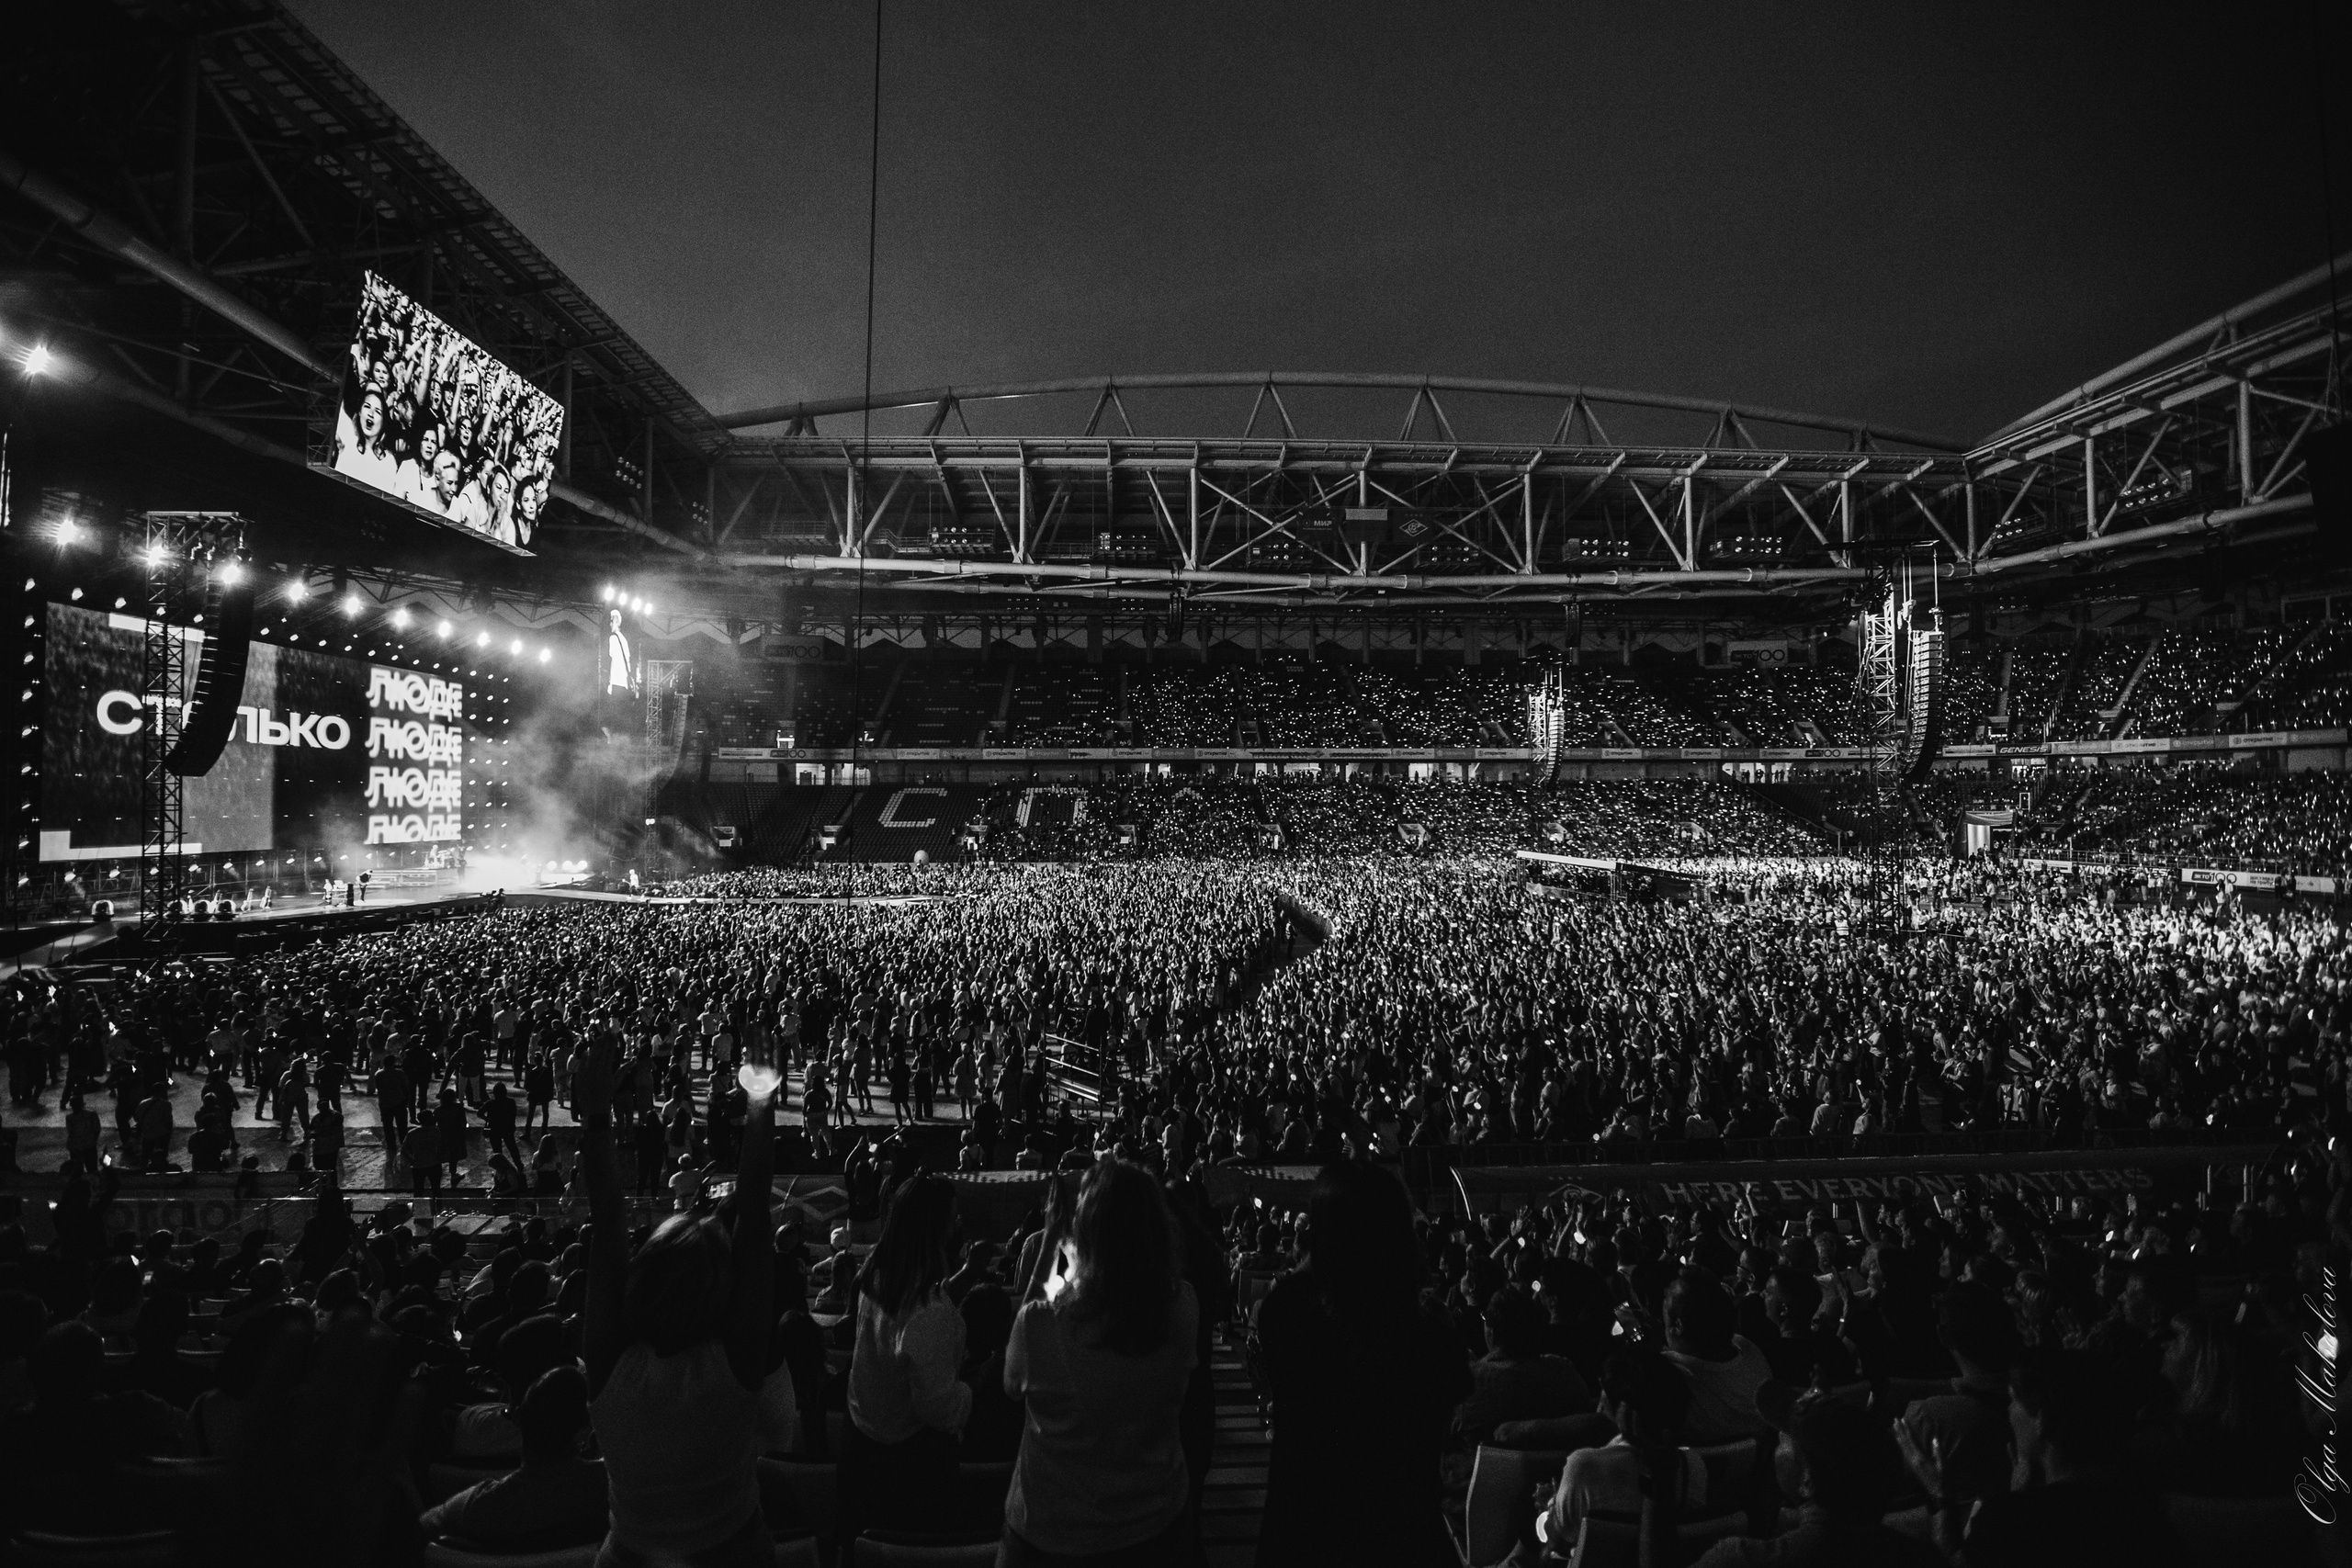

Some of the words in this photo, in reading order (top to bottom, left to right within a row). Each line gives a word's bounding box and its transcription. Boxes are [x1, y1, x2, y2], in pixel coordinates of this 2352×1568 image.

[1999, 746, 2048, 754] GENESIS
[1661, 1179, 1770, 1204] HERE
[1773, 1173, 1968, 1201] EVERYONE
[1976, 1166, 2154, 1196] MATTERS
